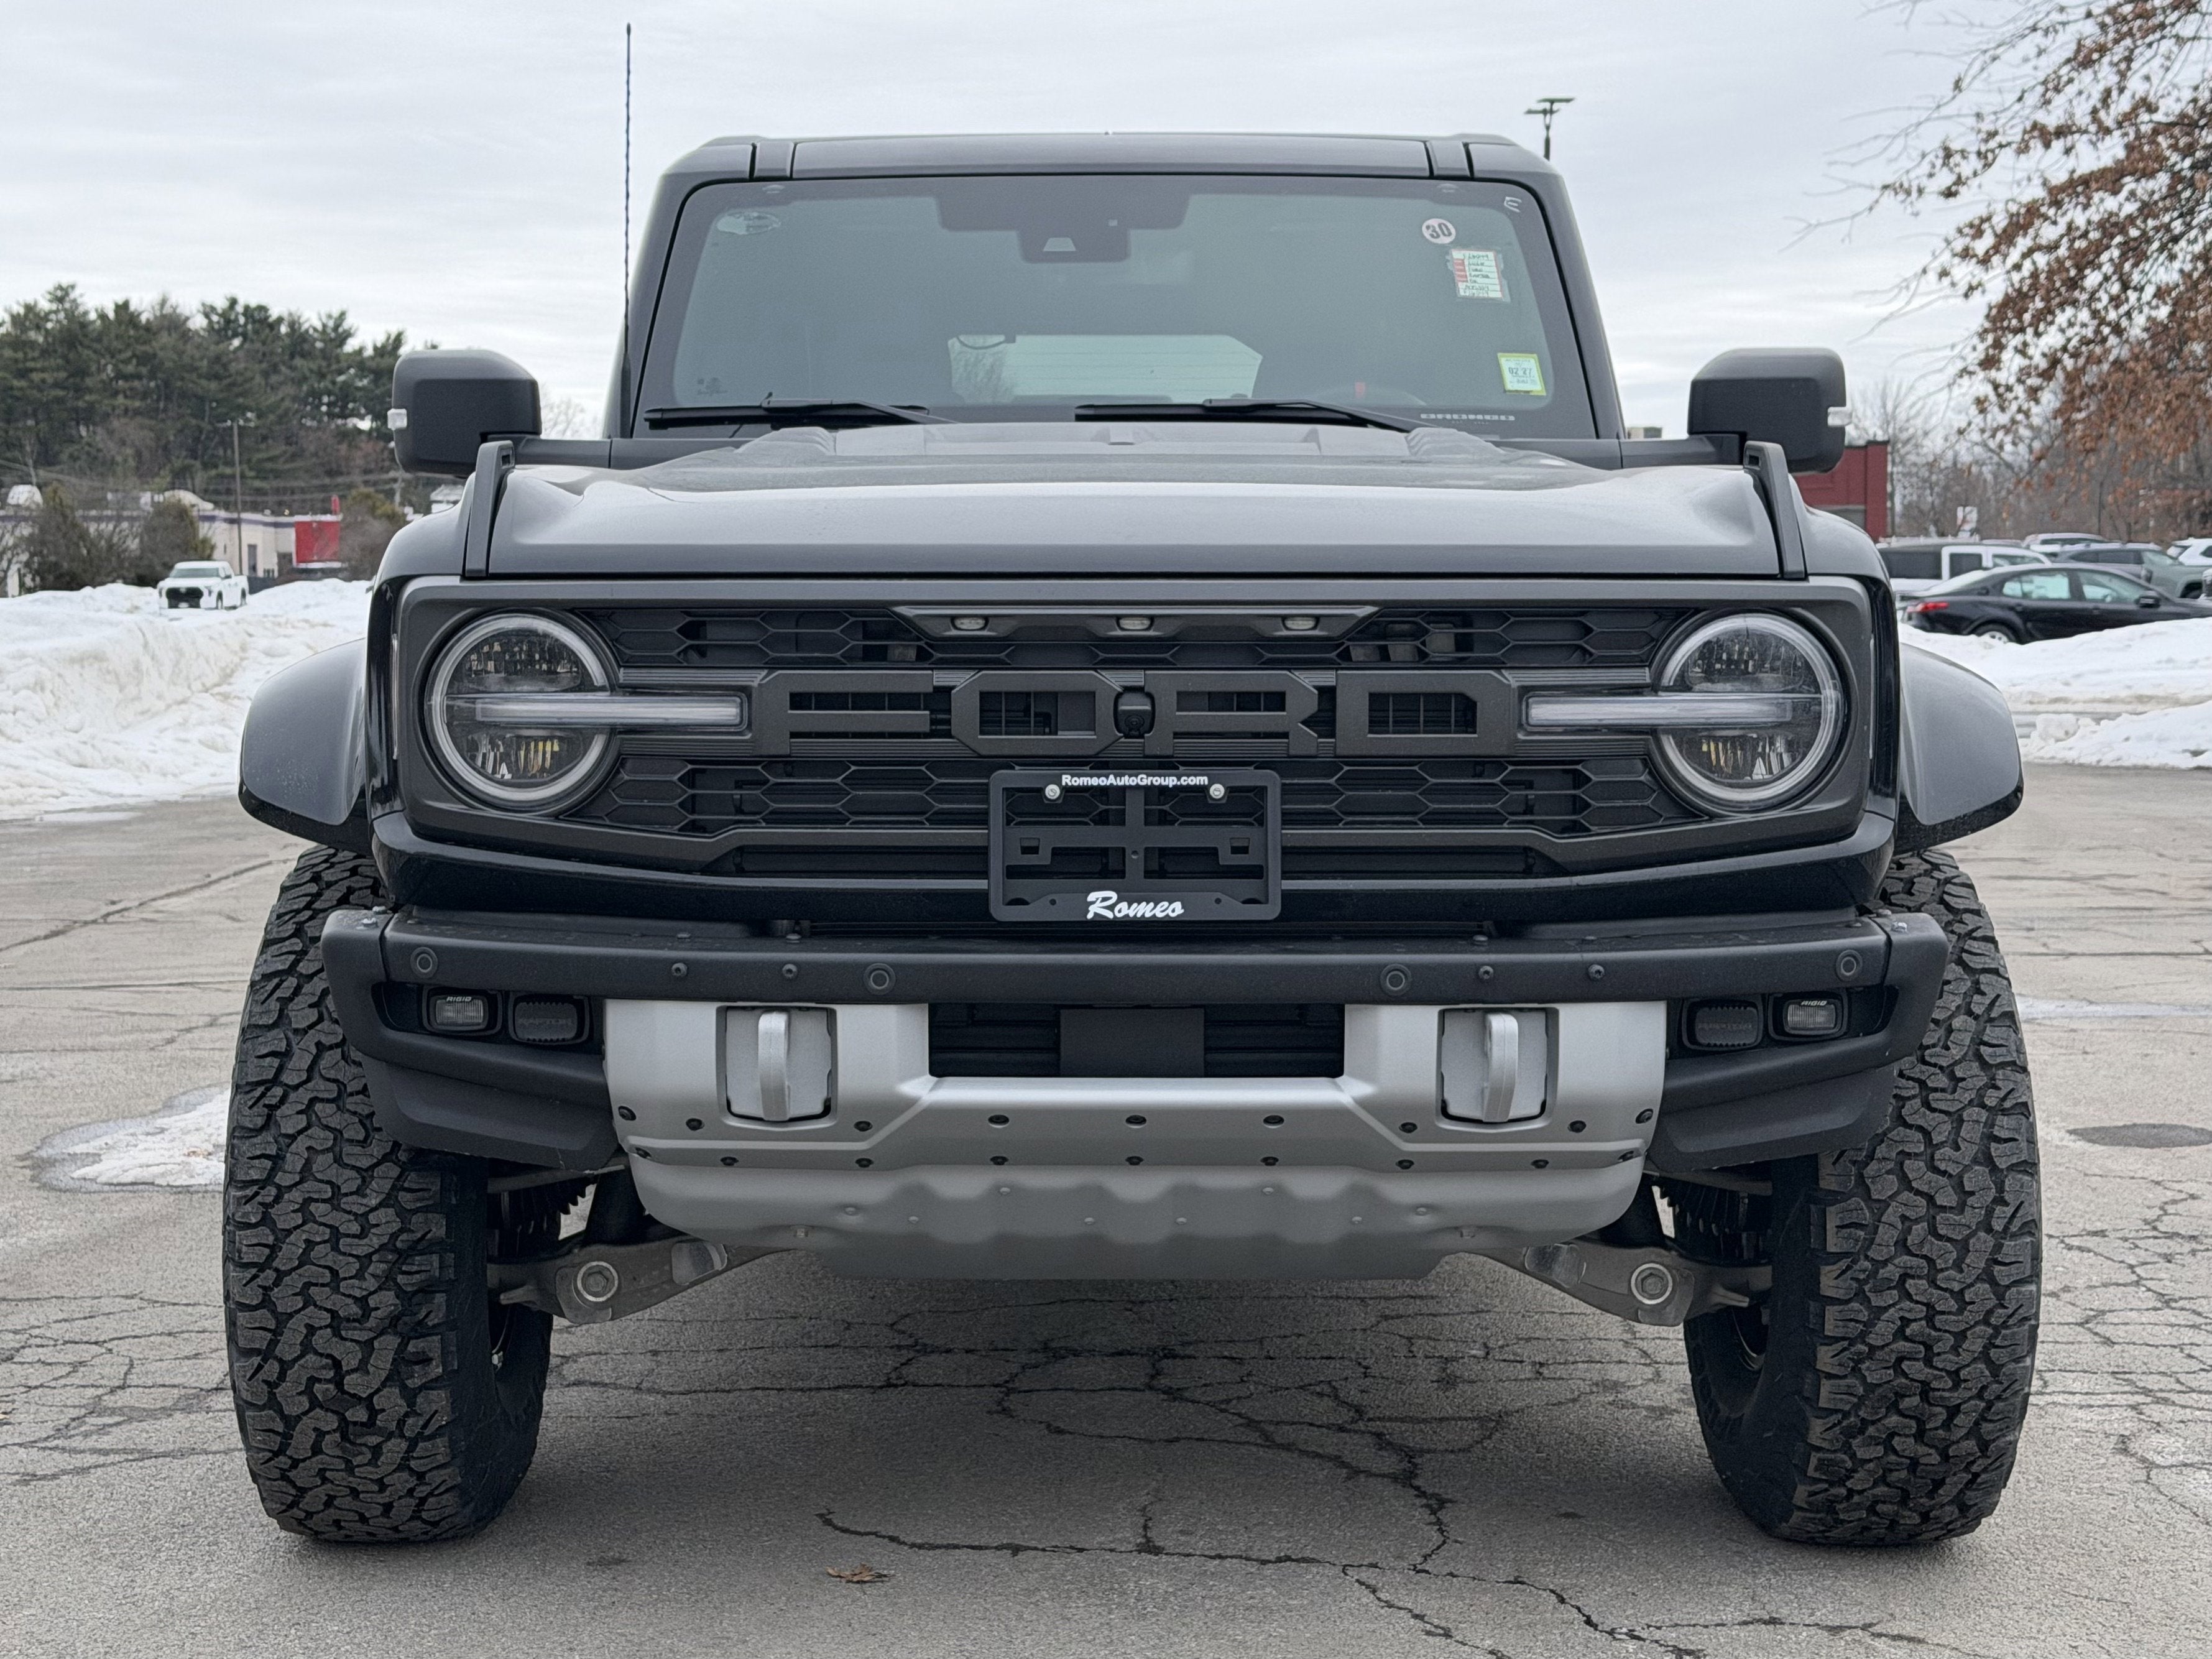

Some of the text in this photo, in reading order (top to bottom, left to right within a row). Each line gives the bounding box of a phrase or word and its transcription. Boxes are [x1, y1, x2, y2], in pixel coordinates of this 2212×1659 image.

[1426, 223, 1452, 239] 30
[754, 670, 1512, 756] FORD
[1062, 775, 1208, 788] RomeoAutoGroup.com
[1087, 891, 1184, 920] Romeo
